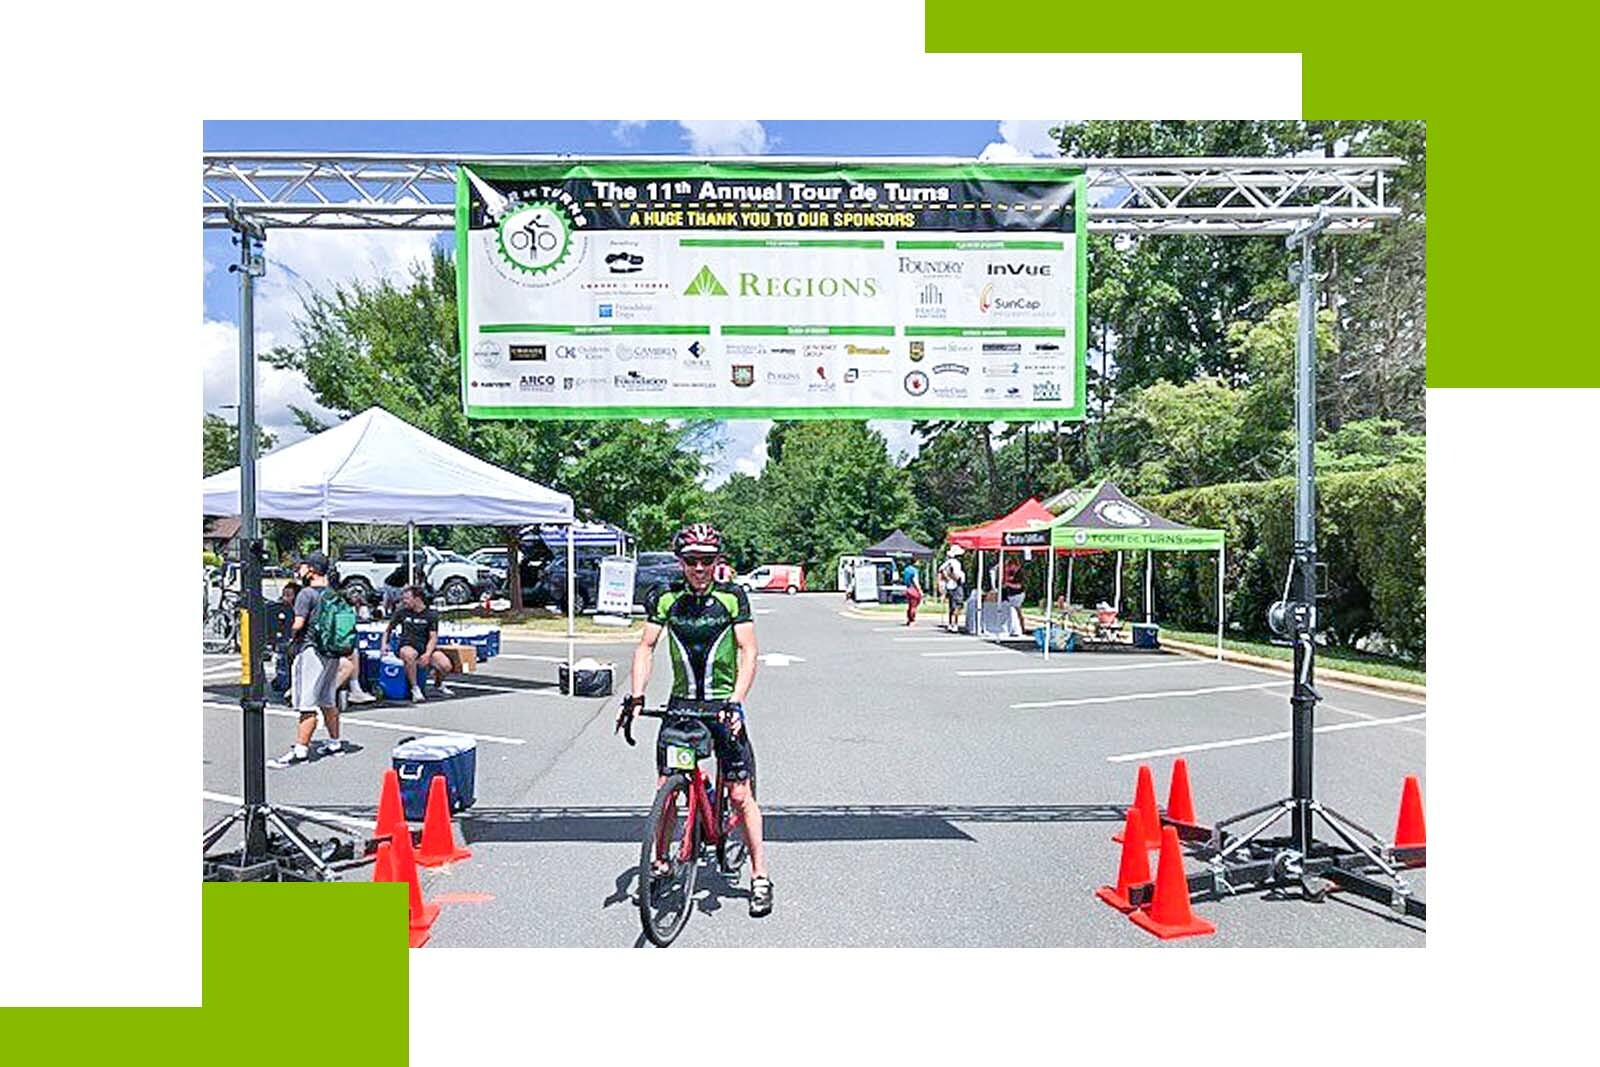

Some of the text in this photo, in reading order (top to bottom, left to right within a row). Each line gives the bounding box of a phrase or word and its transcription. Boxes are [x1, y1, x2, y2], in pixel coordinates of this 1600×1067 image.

[592, 181, 950, 202] The 11th Annual Tour de Turns
[541, 186, 588, 227] TURNS
[629, 211, 916, 229] A HUGE THANK YOU TO OUR SPONSORS
[739, 272, 878, 298] REGIONS
[993, 298, 1041, 311] SunCap
